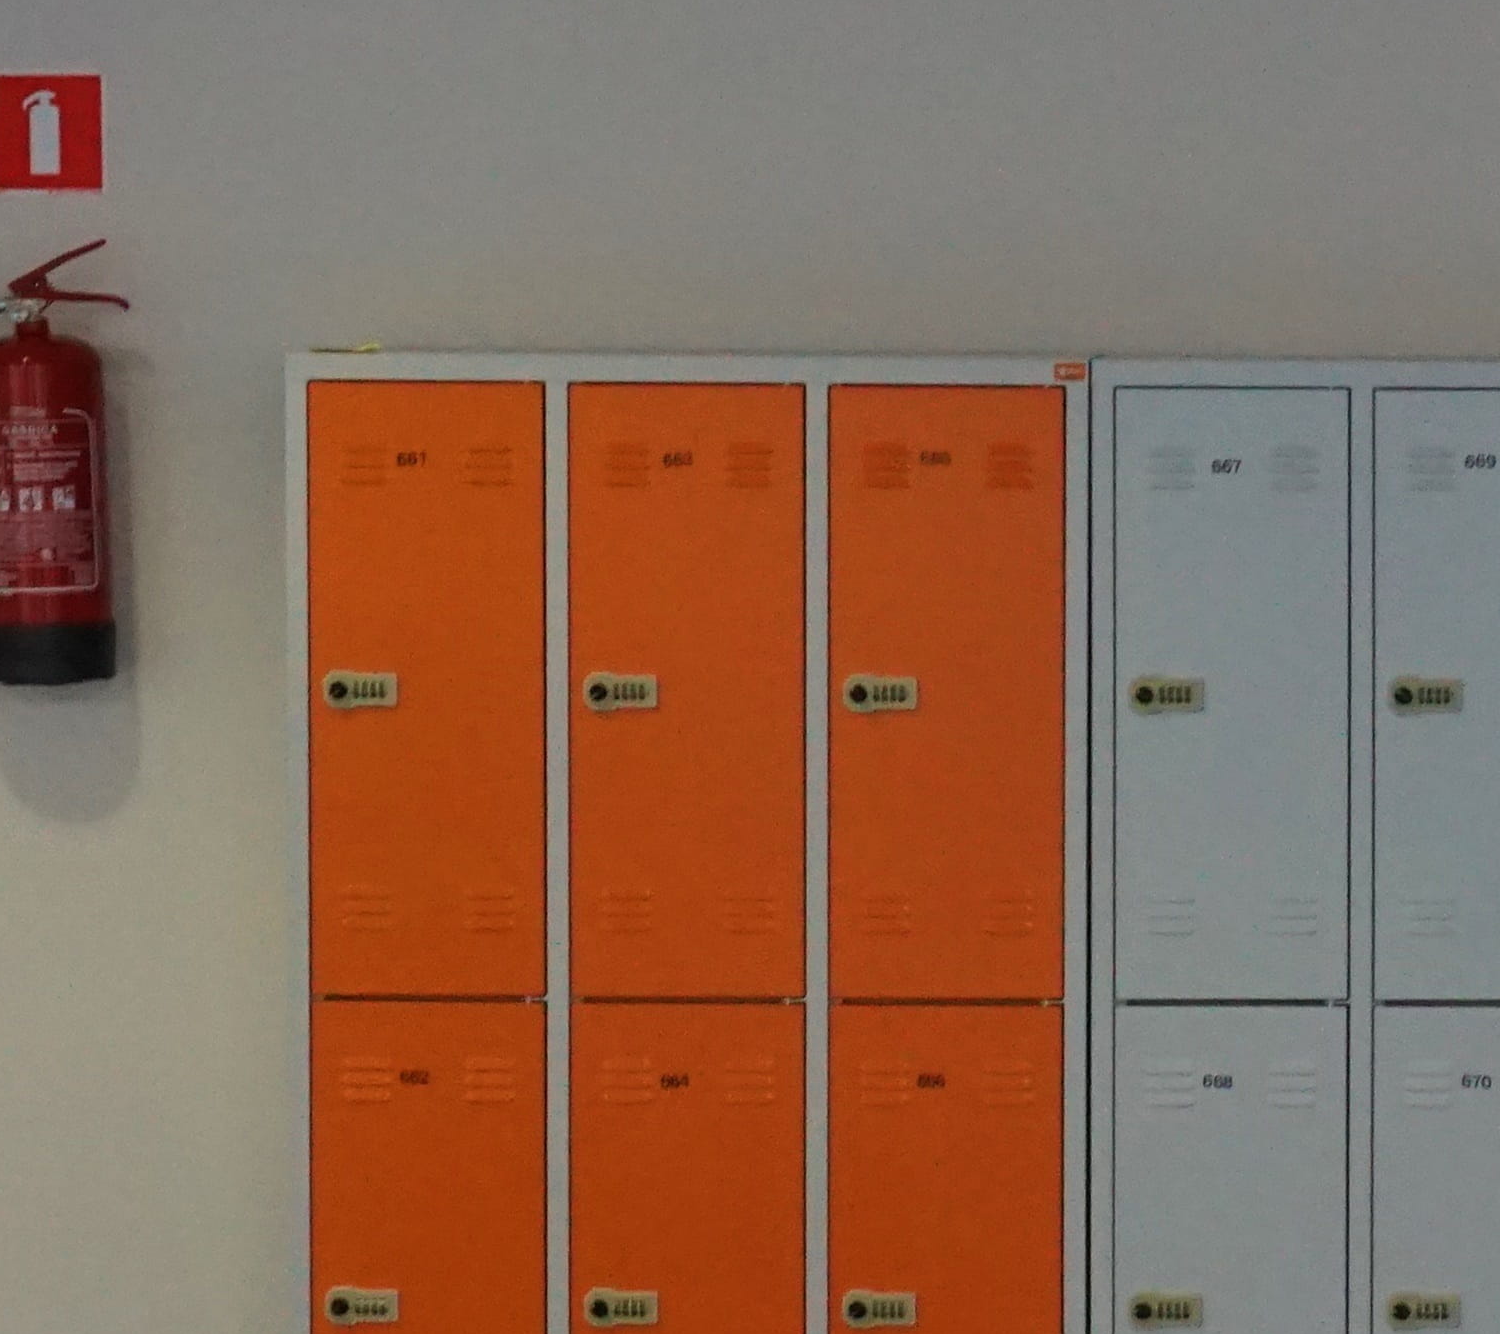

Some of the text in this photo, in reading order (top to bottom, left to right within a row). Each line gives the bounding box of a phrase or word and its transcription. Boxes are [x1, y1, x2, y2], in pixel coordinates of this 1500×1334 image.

[1210, 458, 1243, 475] 667
[1463, 452, 1498, 469] 669
[1202, 1073, 1234, 1090] 668
[1460, 1073, 1493, 1090] 670
